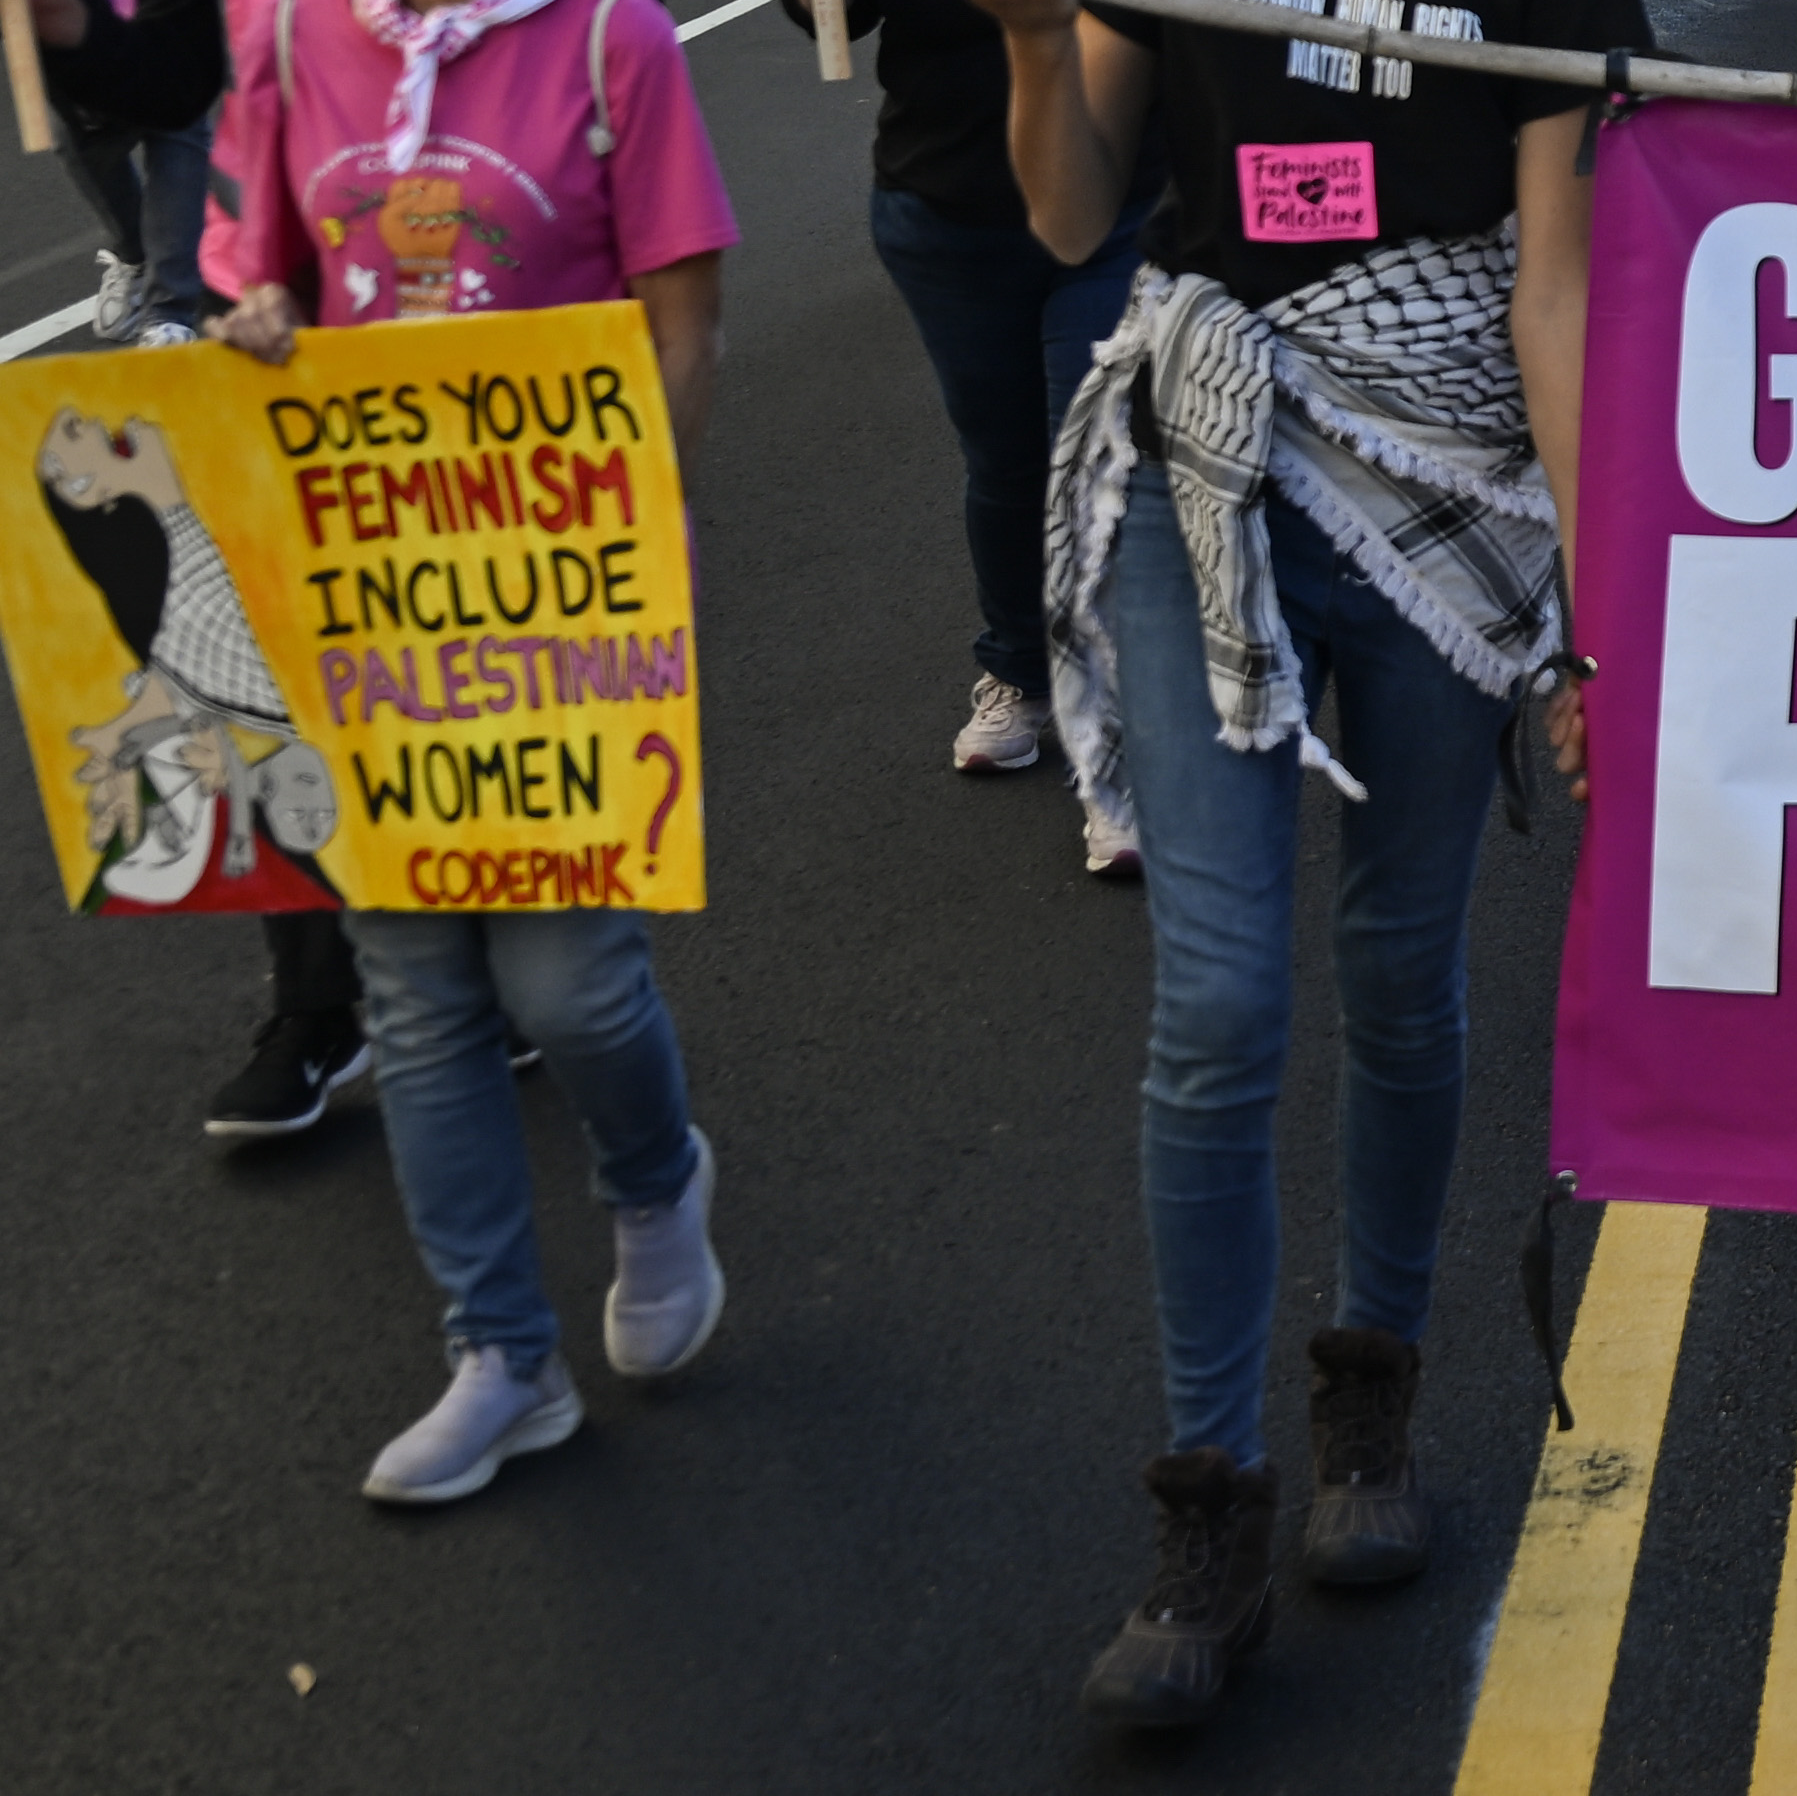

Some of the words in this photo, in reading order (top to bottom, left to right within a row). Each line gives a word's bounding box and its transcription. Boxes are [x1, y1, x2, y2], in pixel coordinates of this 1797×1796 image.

[1372, 56, 1413, 100] TOO
[267, 381, 430, 459] DOES
[440, 365, 642, 448] YOUR
[295, 444, 635, 548] FEMINISM
[306, 540, 644, 637] INCLUDE
[318, 628, 689, 726] PALESTINIAN
[406, 842, 635, 905] CODEPINK
